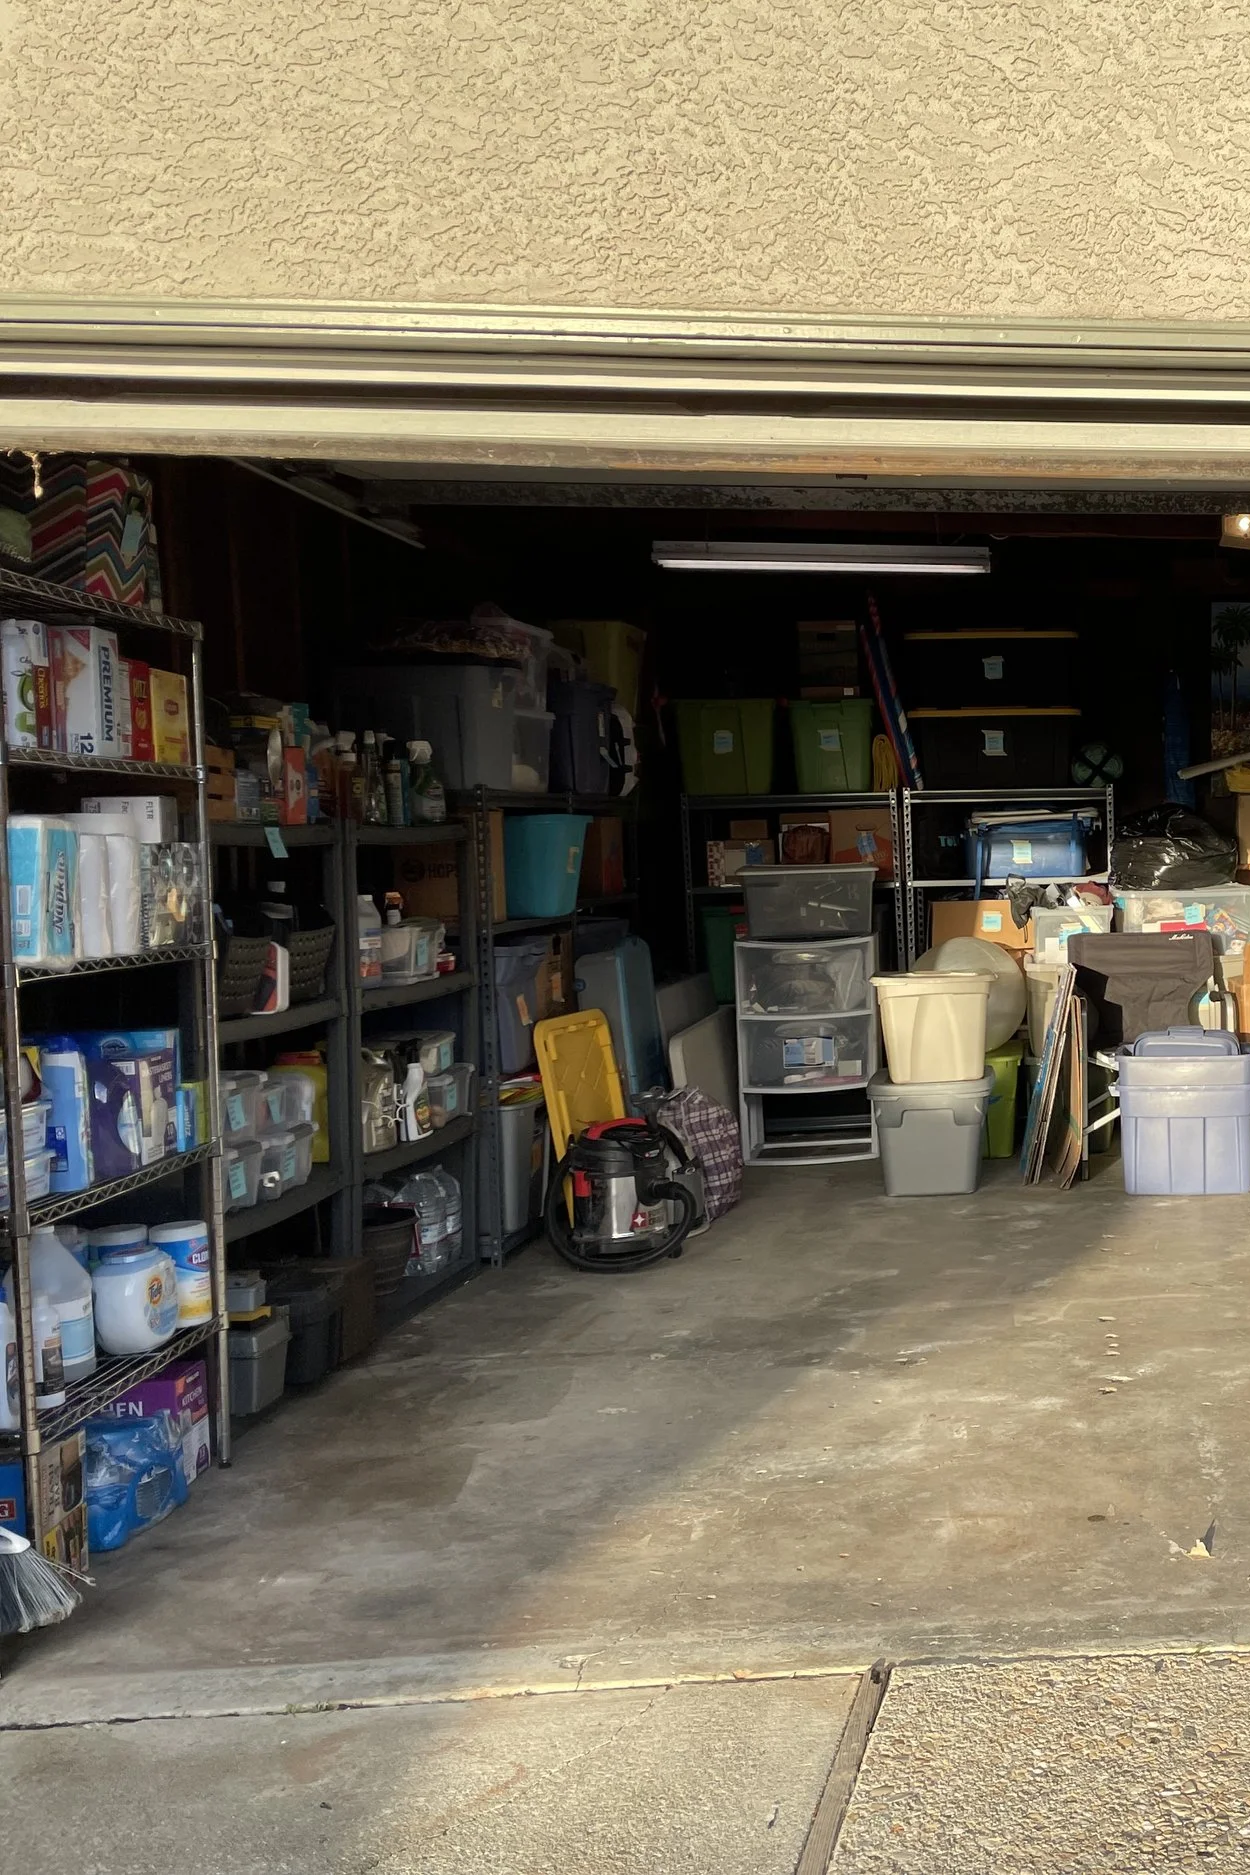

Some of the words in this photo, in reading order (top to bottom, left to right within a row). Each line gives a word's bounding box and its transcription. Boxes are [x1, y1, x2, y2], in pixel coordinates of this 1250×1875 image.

[101, 646, 114, 742] PREMIUM
[80, 732, 94, 754] 12
[121, 801, 129, 814] Fac
[145, 801, 153, 820] FLTR
[52, 848, 68, 936] Napkins
[192, 1249, 209, 1264] CLO
[148, 1283, 162, 1303] Tide
